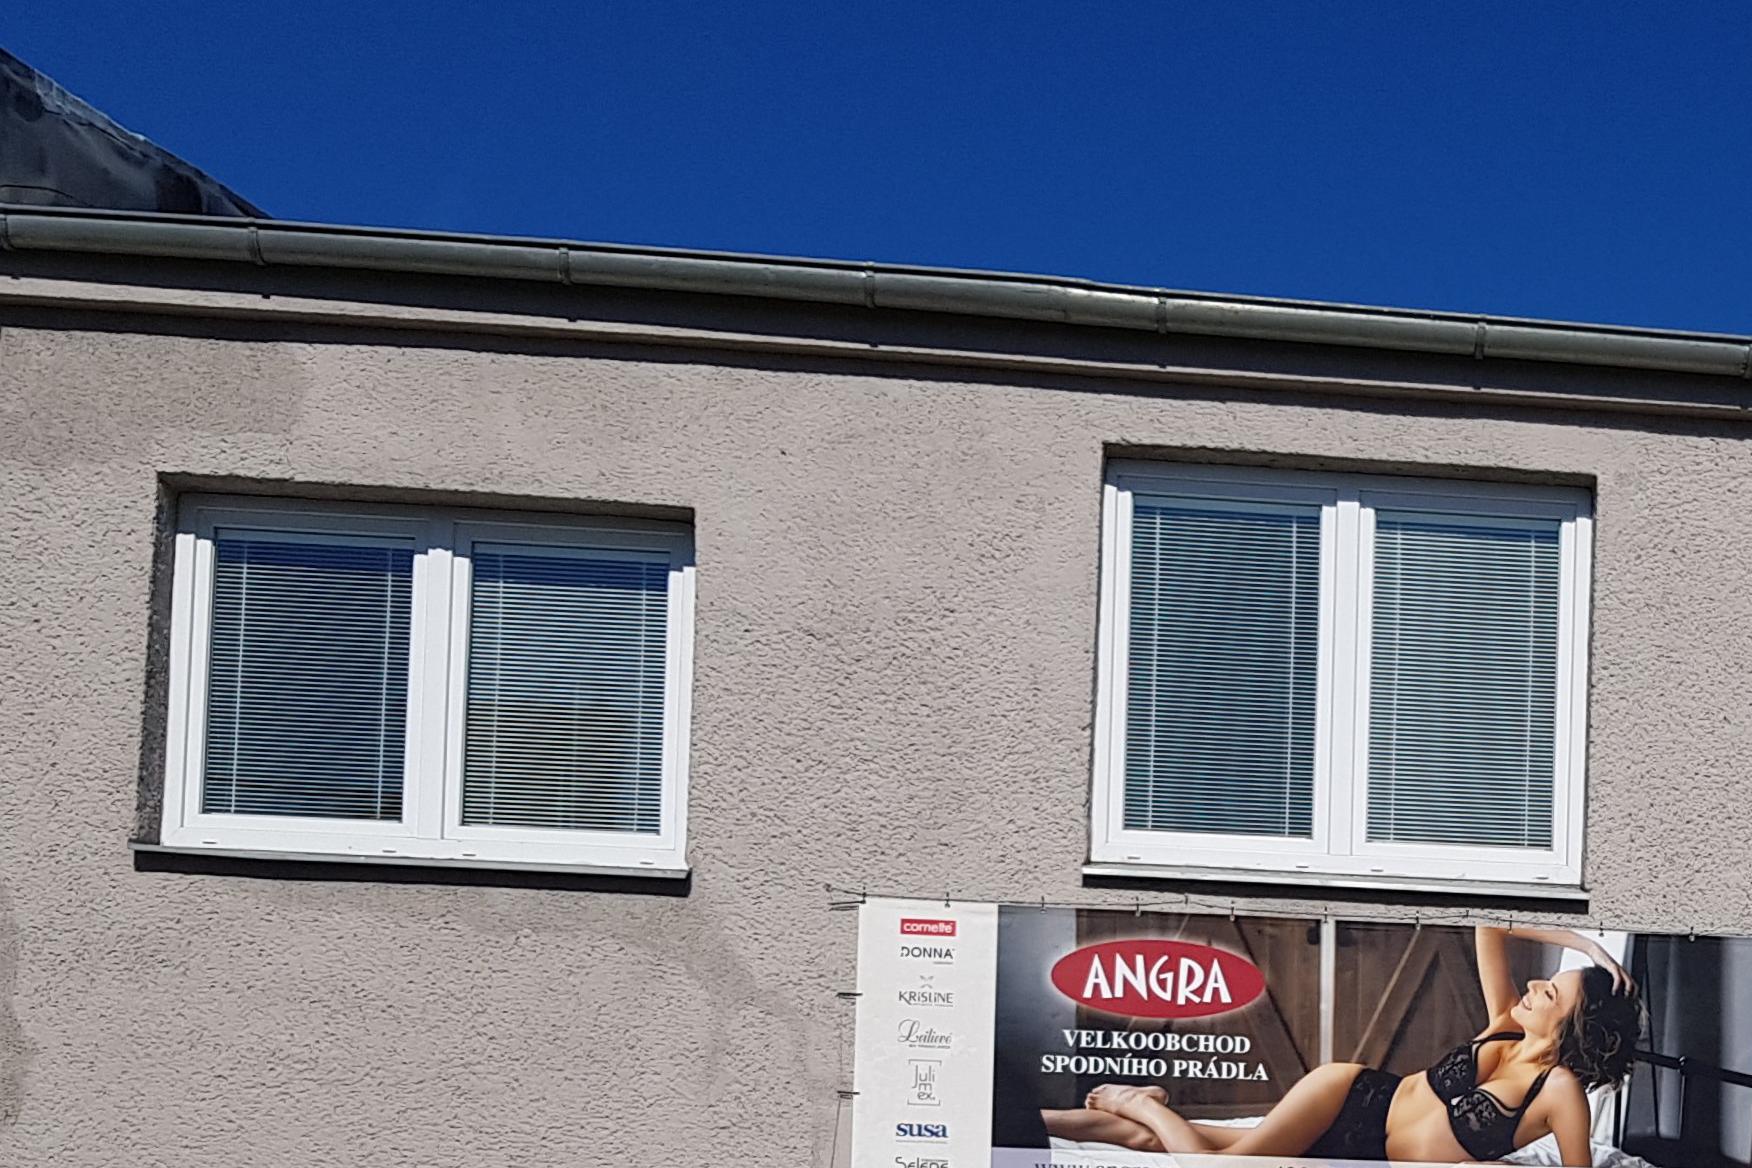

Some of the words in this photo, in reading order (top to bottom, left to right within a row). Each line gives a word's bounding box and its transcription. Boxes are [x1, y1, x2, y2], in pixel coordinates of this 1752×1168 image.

[900, 946, 954, 959] DONNA
[1082, 952, 1233, 1006] ANGRA
[1062, 1028, 1251, 1054] VELKOOBCHOD
[1041, 1053, 1168, 1077] SPODNÍHO
[1171, 1055, 1270, 1081] PRÁDLA
[896, 1123, 949, 1138] susa
